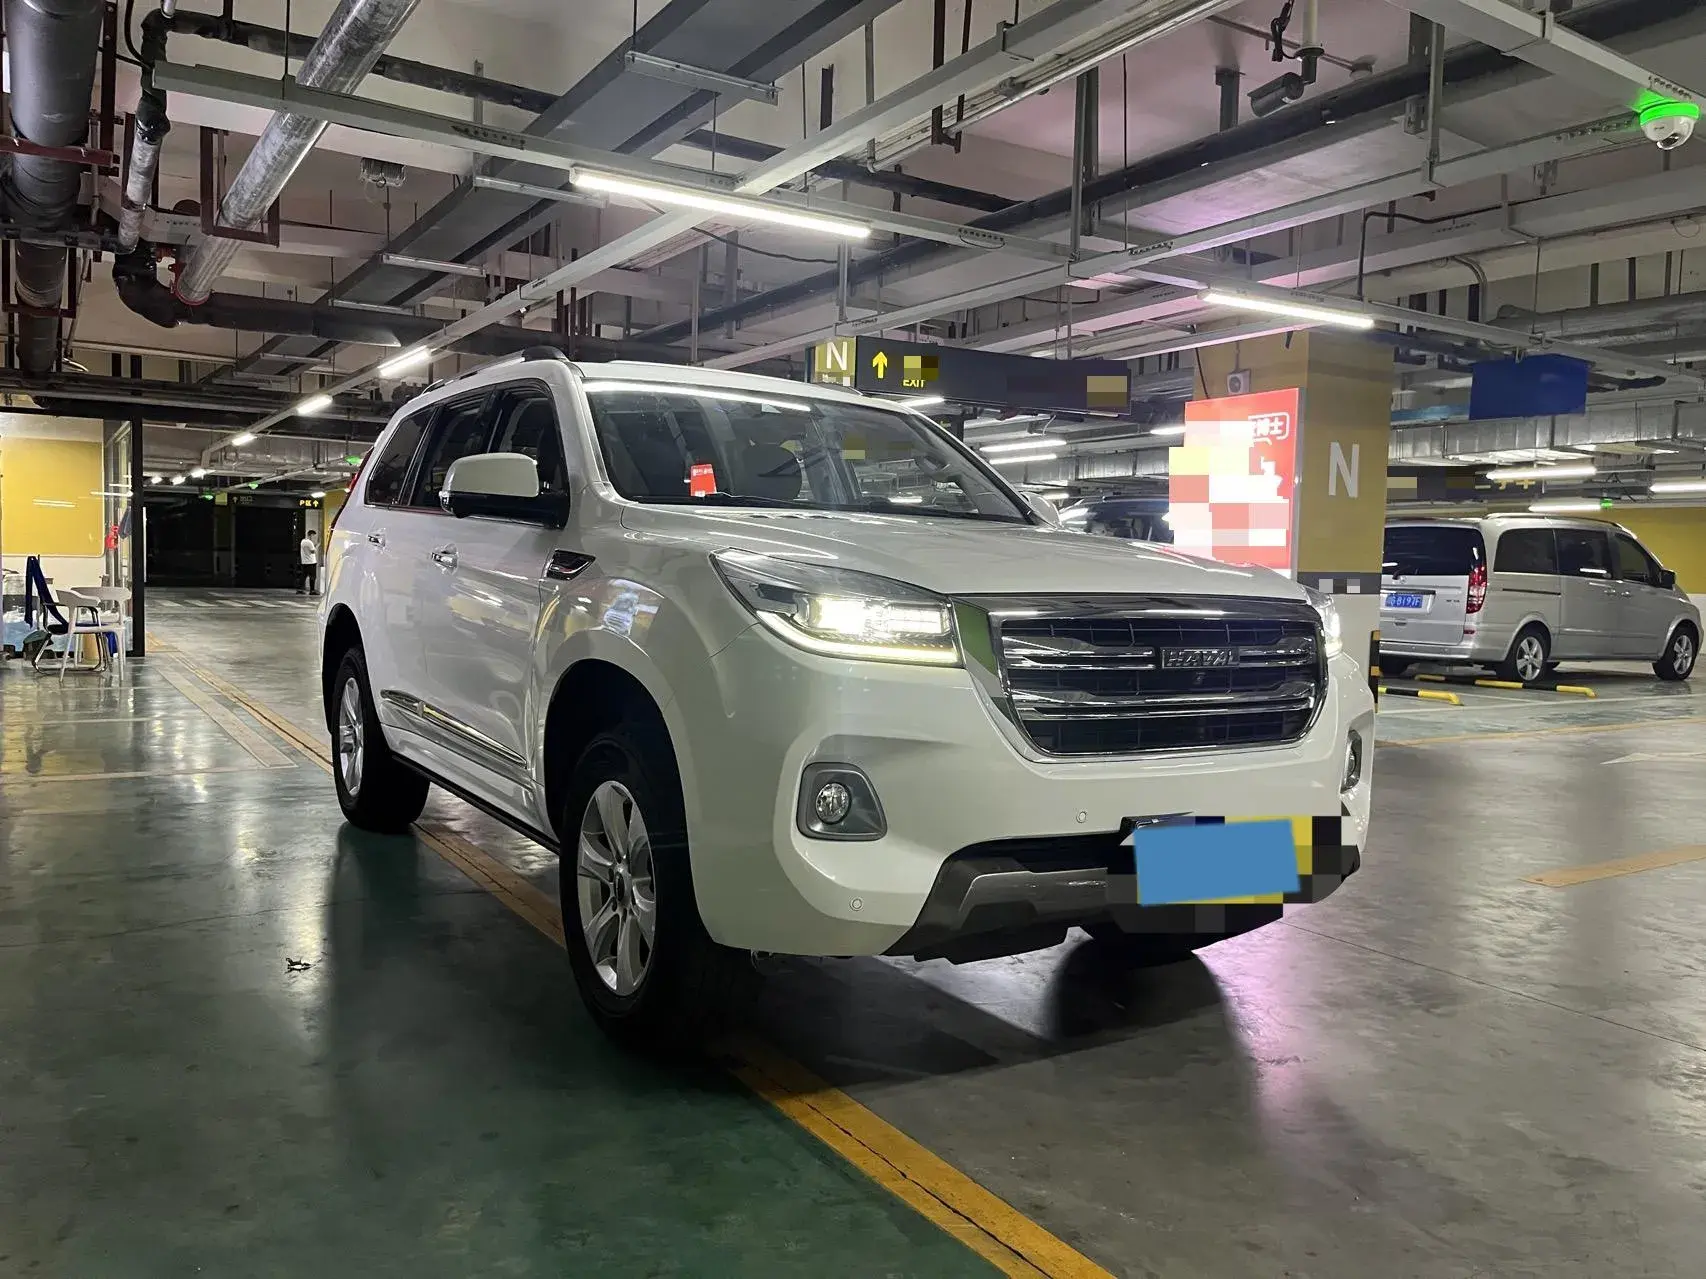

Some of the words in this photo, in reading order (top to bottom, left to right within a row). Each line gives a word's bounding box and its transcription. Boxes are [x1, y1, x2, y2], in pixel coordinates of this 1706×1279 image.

[826, 341, 848, 371] N
[903, 379, 926, 388] EXIT
[1328, 441, 1360, 498] N
[1166, 650, 1239, 667] HAVAL
